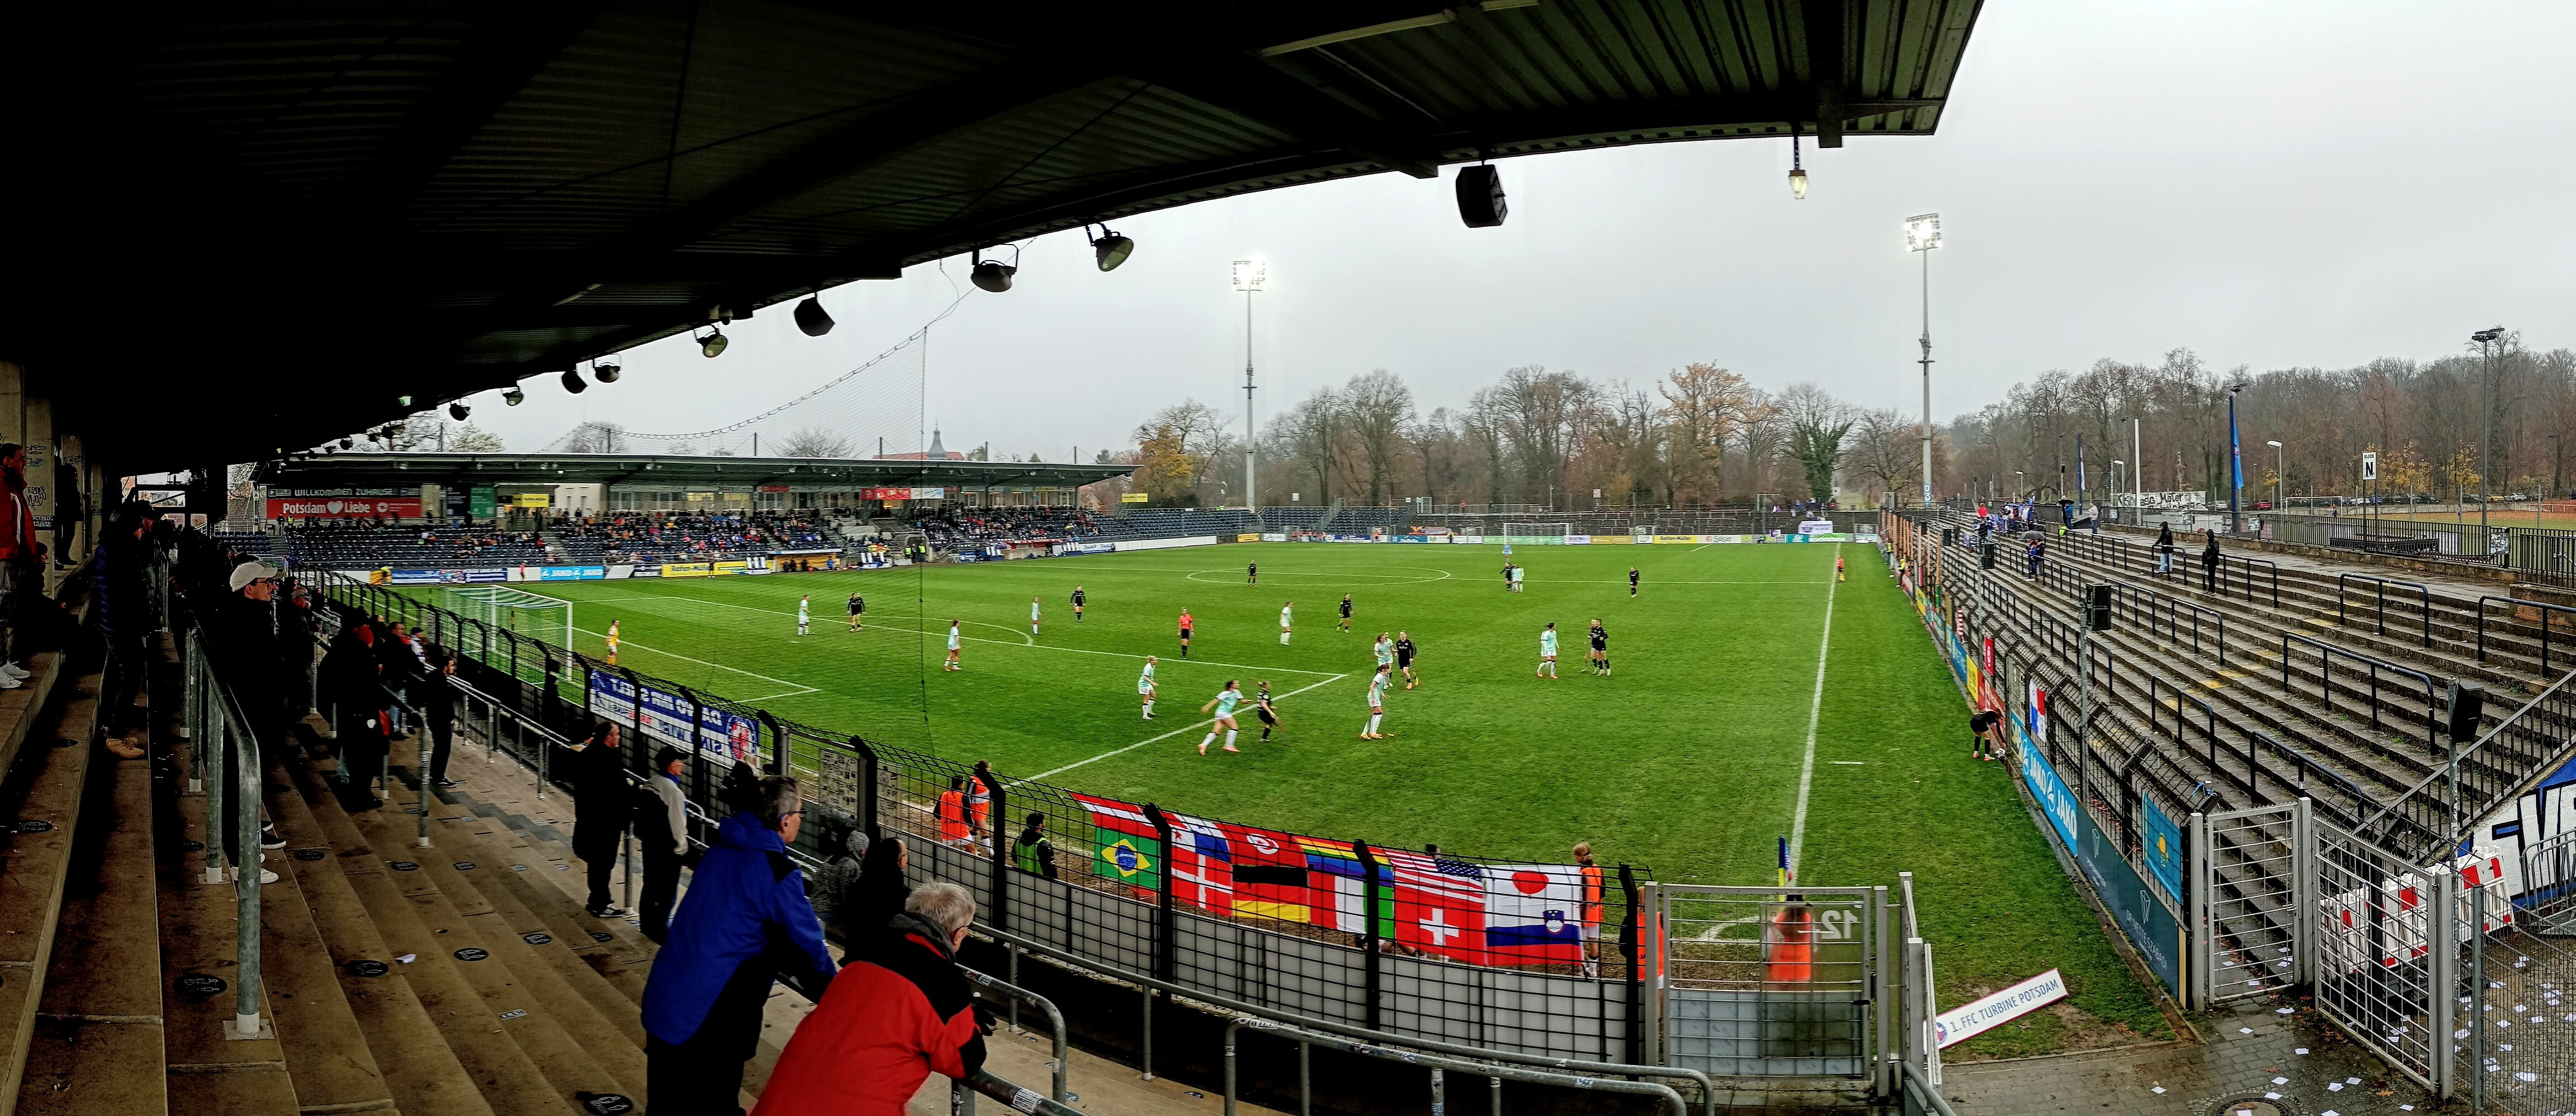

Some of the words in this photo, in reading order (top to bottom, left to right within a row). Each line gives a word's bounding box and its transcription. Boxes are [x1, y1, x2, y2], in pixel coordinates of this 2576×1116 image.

[2366, 462, 2373, 477] N
[283, 503, 326, 514] Potsdam
[344, 501, 371, 513] Liebe
[2030, 753, 2046, 795] JAKO
[2056, 789, 2077, 840] JAKO
[1979, 997, 2018, 1020] TURBINE
[2018, 980, 2059, 1004] POTSDAM
